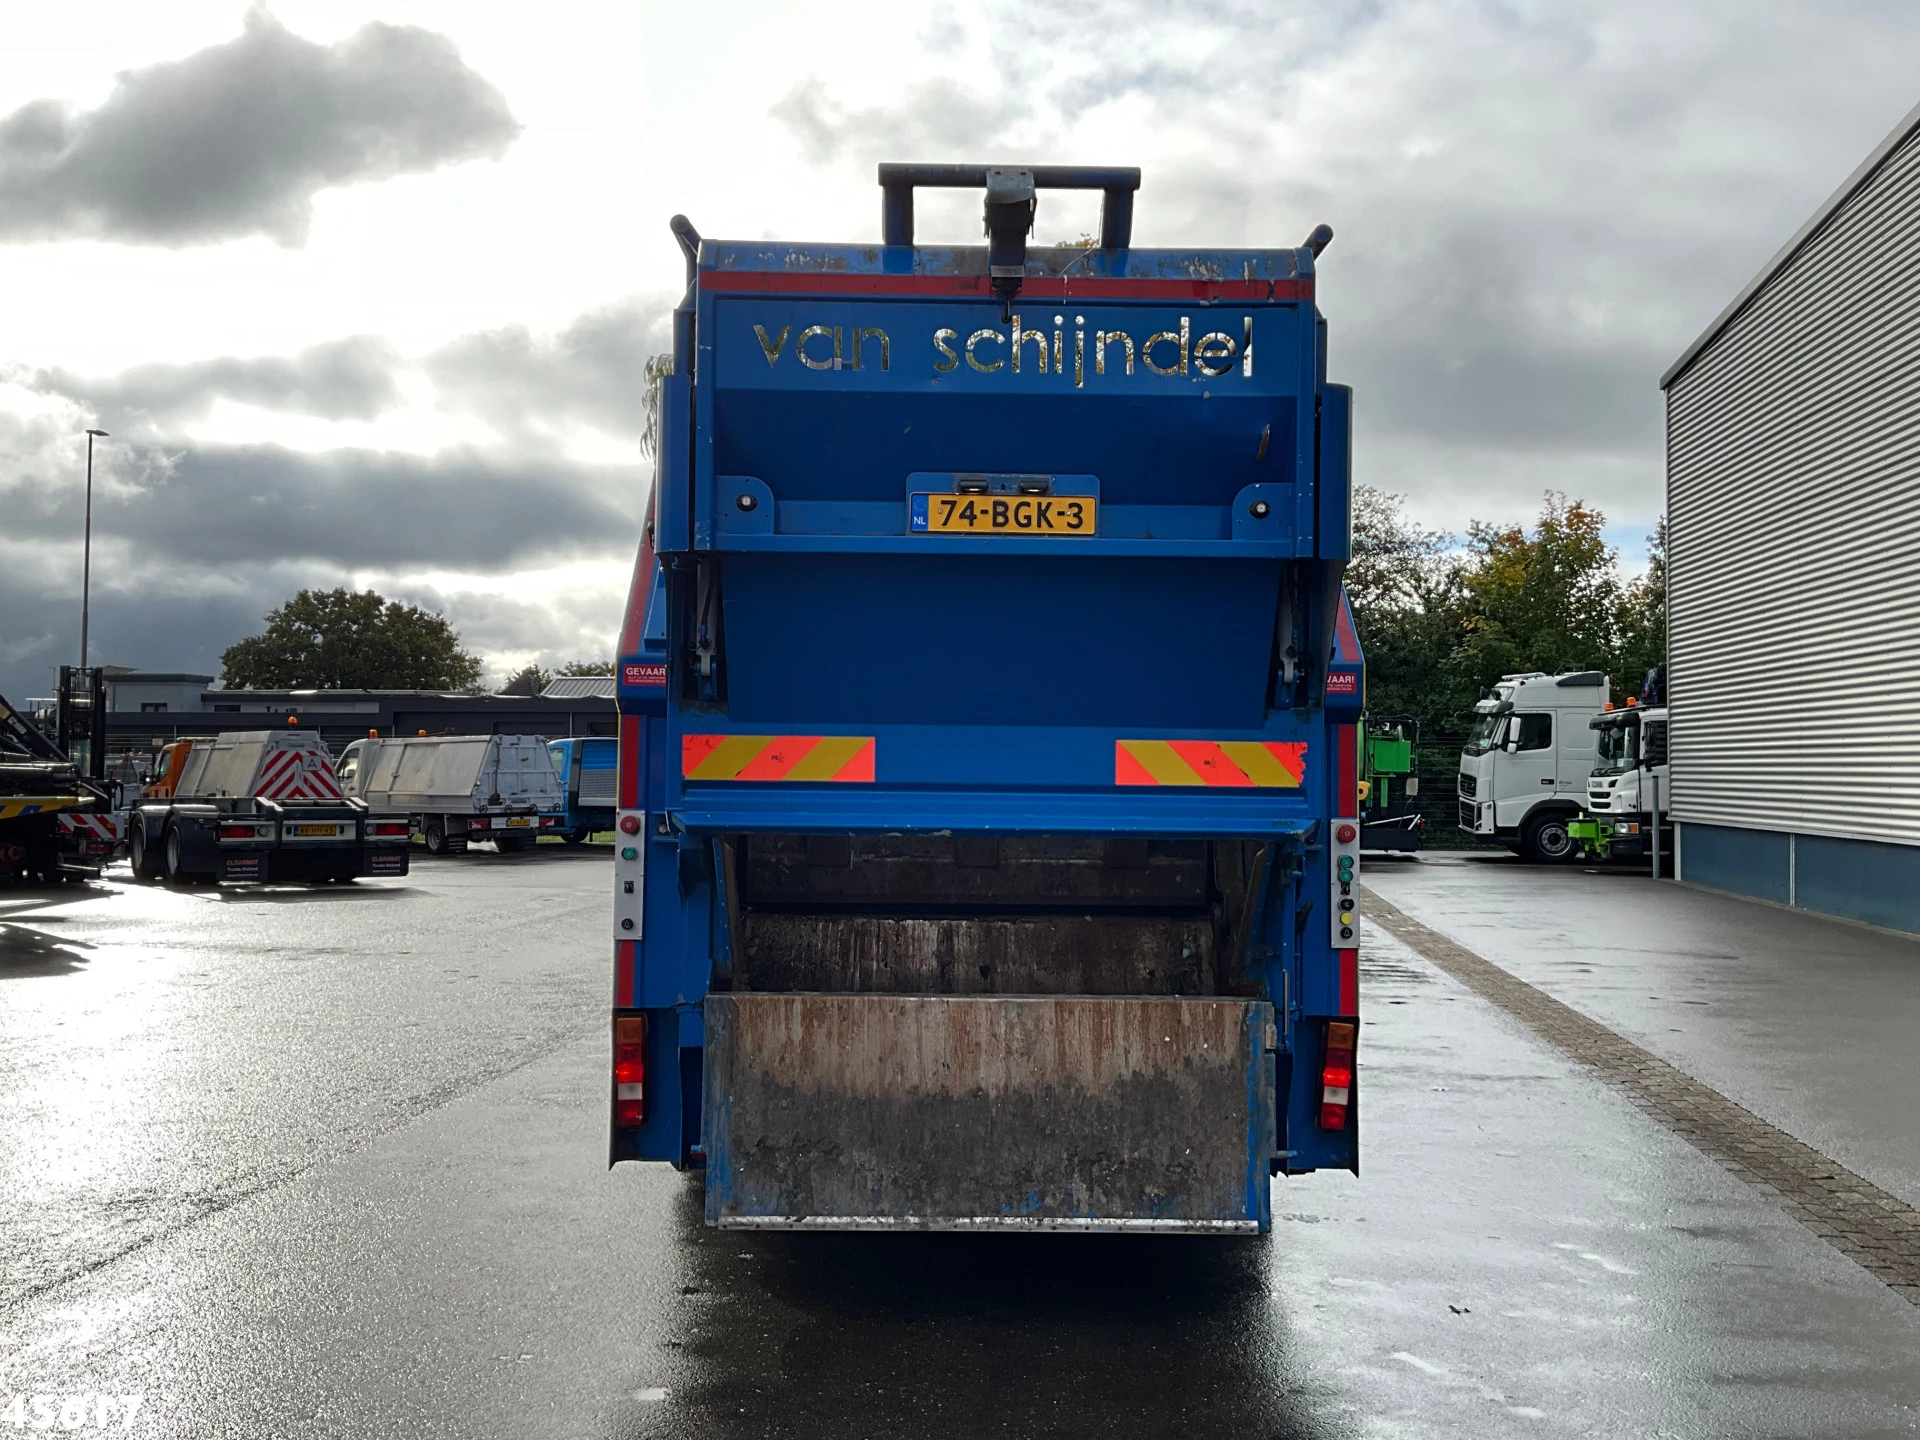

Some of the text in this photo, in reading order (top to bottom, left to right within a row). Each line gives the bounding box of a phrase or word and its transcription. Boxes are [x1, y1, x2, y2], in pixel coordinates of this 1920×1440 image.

[753, 314, 1253, 388] van schijndel
[913, 516, 926, 525] NL
[940, 499, 1084, 529] 74-BGK-3
[307, 758, 317, 769] A
